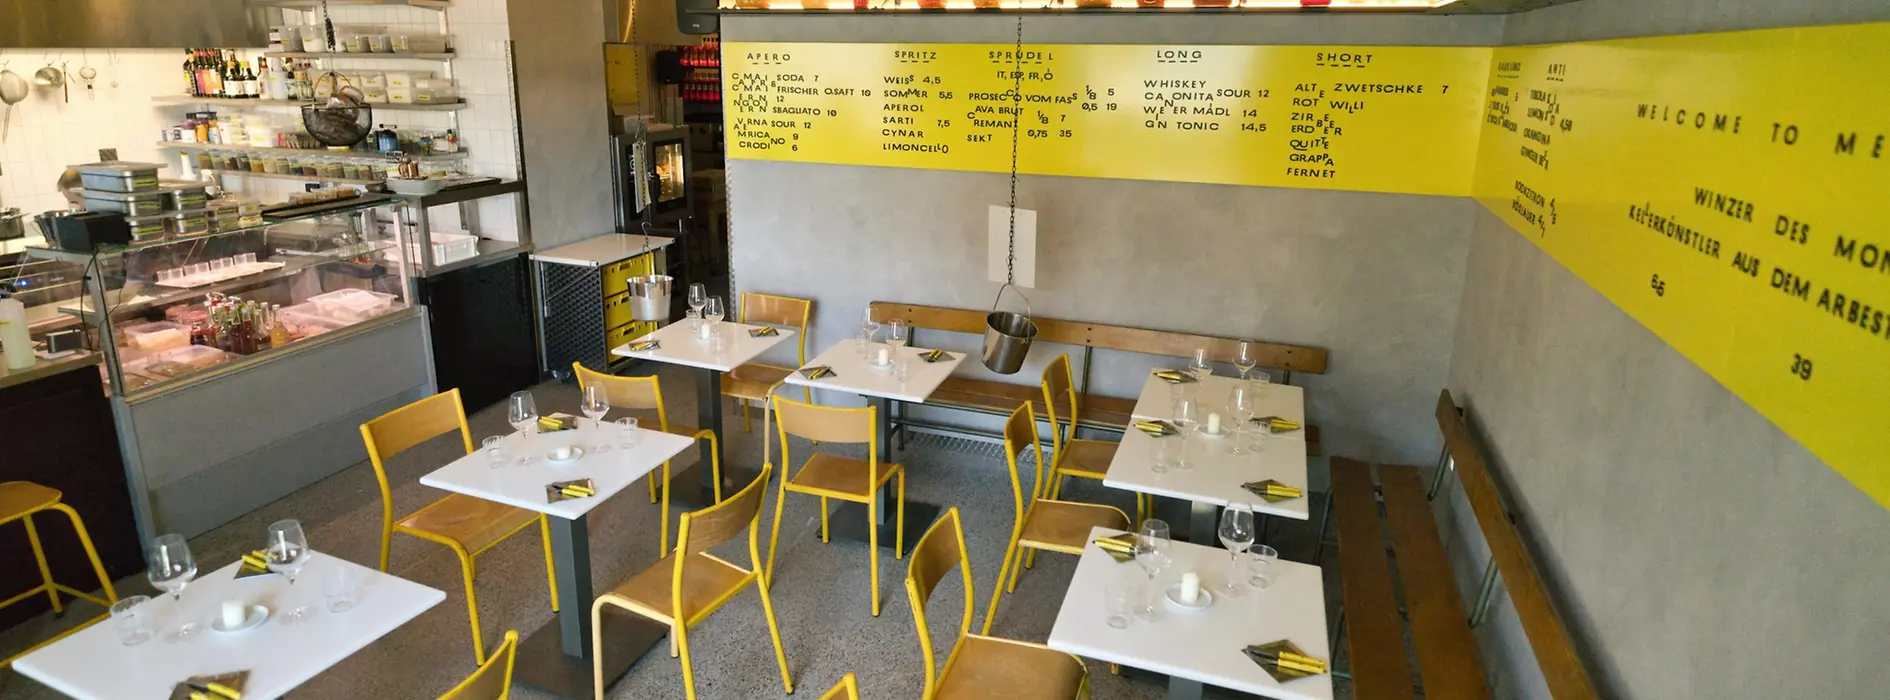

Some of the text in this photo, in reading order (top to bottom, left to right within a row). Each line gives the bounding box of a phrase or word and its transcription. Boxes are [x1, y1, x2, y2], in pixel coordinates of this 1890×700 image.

[747, 53, 791, 61] APERO
[894, 50, 937, 60] SPRITZ
[989, 51, 1053, 60] SPRUDEL
[1157, 50, 1202, 59] LONG
[1316, 52, 1373, 64] SHORT
[776, 74, 805, 82] SODA
[883, 74, 941, 85] WEISS 4,5
[1144, 80, 1207, 88] WHISKEY
[1334, 83, 1423, 94] ZWETSCHKE
[1442, 85, 1449, 94] 7
[776, 86, 819, 96] FRISCHER
[861, 89, 872, 97] 10
[883, 88, 928, 98] SOMMER
[968, 89, 1022, 101] PROSECCO
[1025, 94, 1052, 103] VOM
[1055, 92, 1078, 104] FASS
[1107, 88, 1115, 96] 5
[1216, 88, 1251, 98] SOUR
[1258, 89, 1270, 98] 12
[772, 106, 821, 116] SBAGLIATO
[827, 109, 838, 117] 10
[883, 103, 925, 112] APEROL
[998, 106, 1025, 116] BRUT
[1106, 102, 1117, 111] 19
[1329, 101, 1364, 114] WILLI
[1060, 114, 1066, 122] 7
[1242, 109, 1258, 118] 14
[771, 120, 797, 128] SOUR
[882, 116, 951, 128] SARTI 7,5
[1176, 121, 1219, 131] TONIC
[1240, 123, 1267, 132] 14,5
[1637, 103, 1742, 134] WELCOME
[1771, 122, 1799, 145] TO
[881, 128, 924, 138] CYNAR
[967, 134, 993, 142] SEKT
[1059, 129, 1072, 138] 35
[882, 143, 949, 154] LIMONCELLO
[1289, 137, 1329, 151] QUITTE
[1289, 153, 1334, 166] GRAPPA
[1286, 167, 1336, 178] FERNET
[1694, 186, 1754, 223] WINZER
[1774, 214, 1811, 245] DES
[1731, 251, 1760, 277] AUS
[1770, 268, 1812, 301] DEM
[1791, 353, 1813, 381] 39
